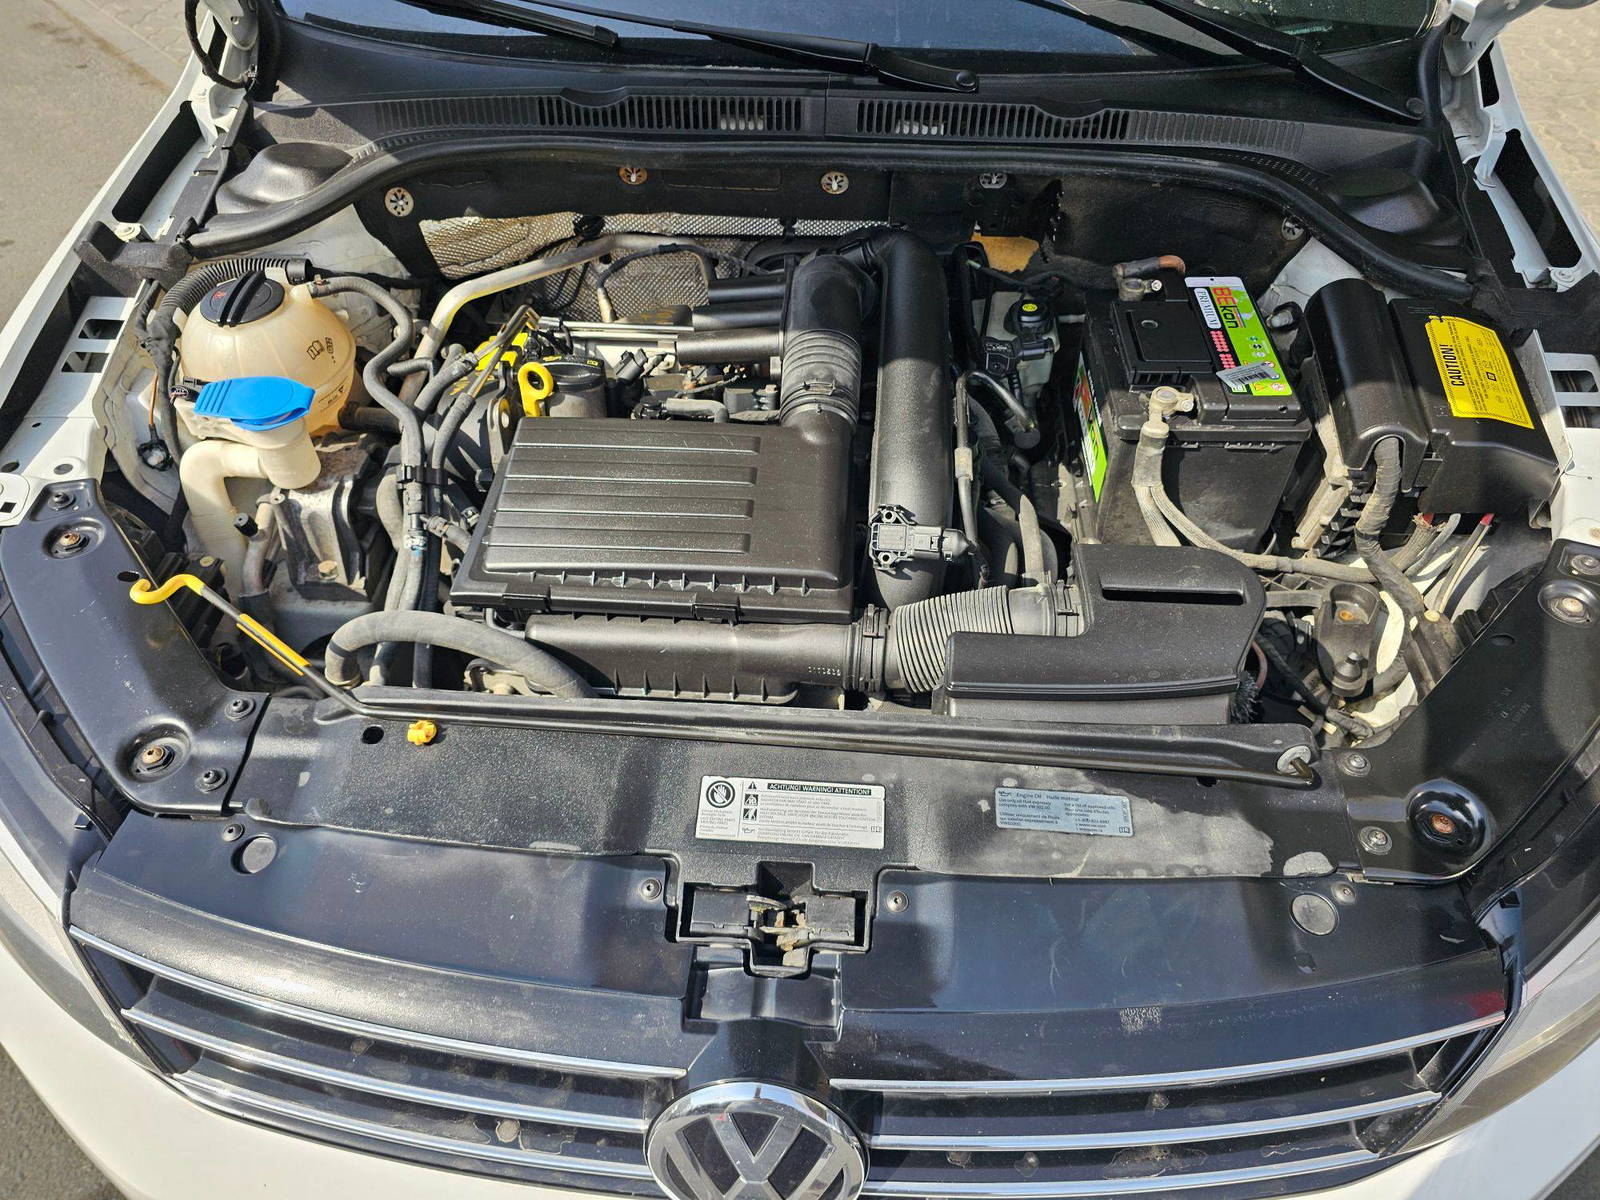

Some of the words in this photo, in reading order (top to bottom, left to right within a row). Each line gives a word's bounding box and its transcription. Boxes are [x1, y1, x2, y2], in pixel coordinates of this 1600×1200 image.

[1197, 291, 1219, 325] PREMIUM
[1212, 287, 1239, 328] BEkon
[1439, 344, 1465, 386] CAUTION!
[769, 783, 801, 791] ACHTUNG!
[802, 785, 834, 793] WARNING!
[834, 787, 870, 796] ATTENTION!
